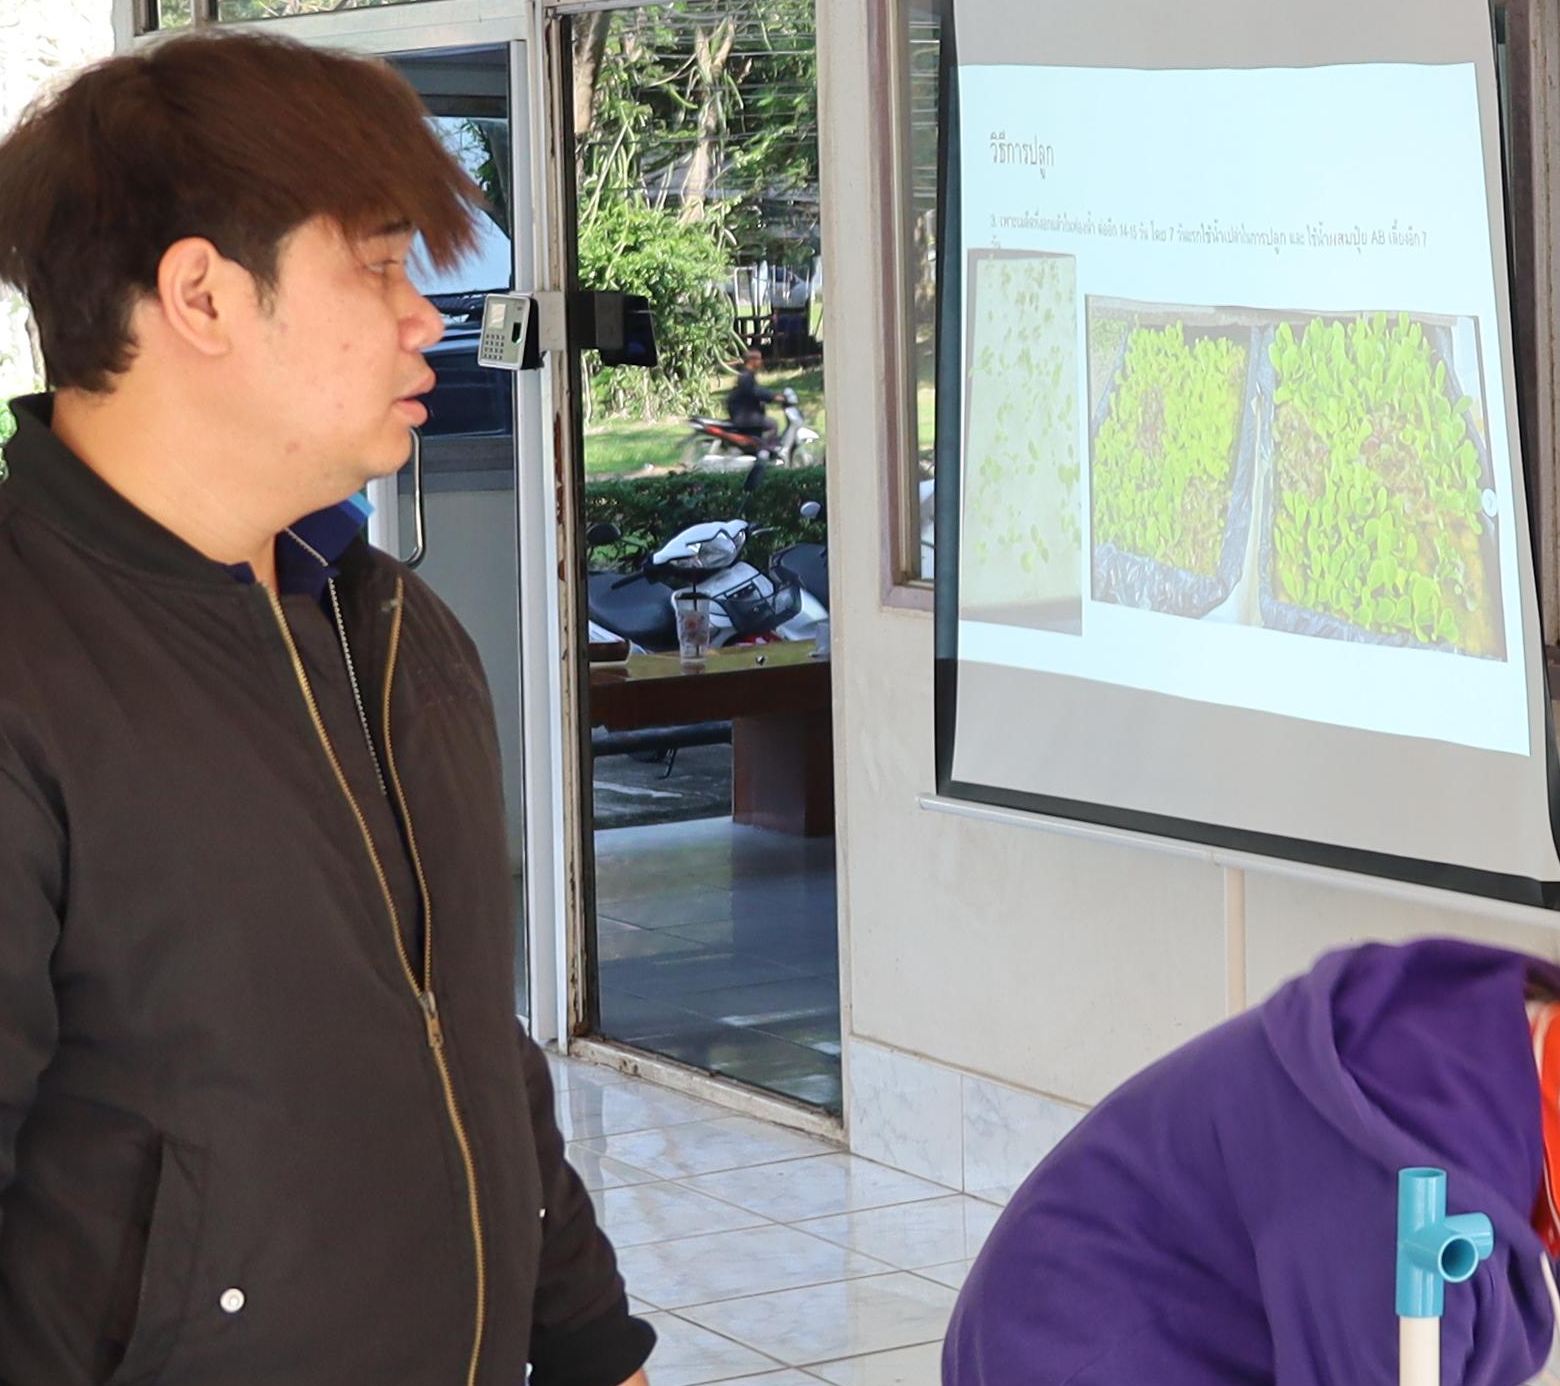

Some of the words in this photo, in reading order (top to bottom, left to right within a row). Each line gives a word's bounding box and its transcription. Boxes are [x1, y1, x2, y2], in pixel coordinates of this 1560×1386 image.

[990, 131, 1055, 180] วิธีการปลูก
[1150, 220, 1167, 242] โดย
[1371, 229, 1386, 246] AB
